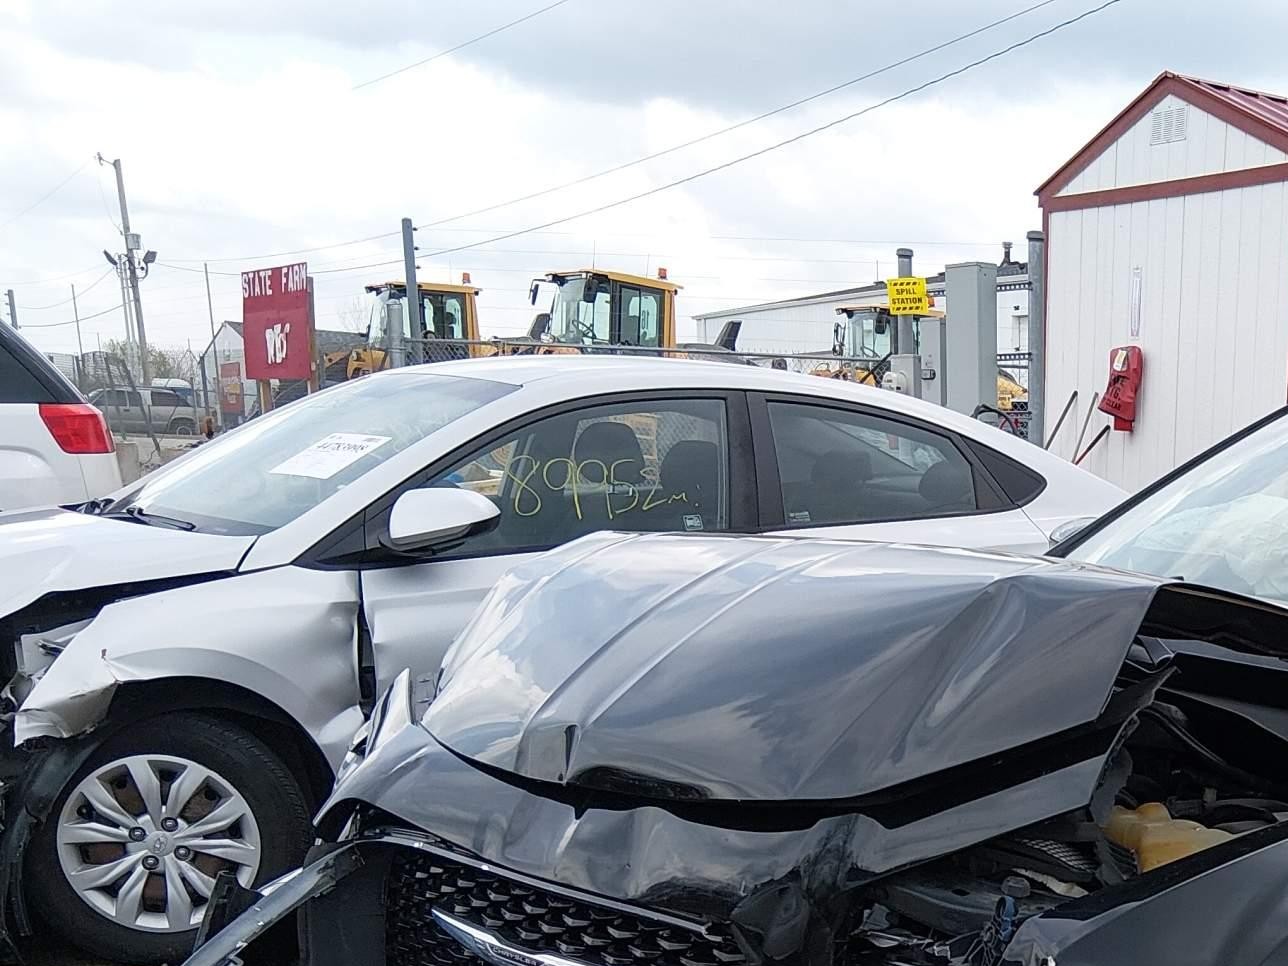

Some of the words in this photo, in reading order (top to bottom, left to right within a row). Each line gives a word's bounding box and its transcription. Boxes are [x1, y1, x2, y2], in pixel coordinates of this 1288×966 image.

[242, 269, 273, 298] STATE
[281, 263, 307, 293] FARM
[891, 297, 923, 305] STATION
